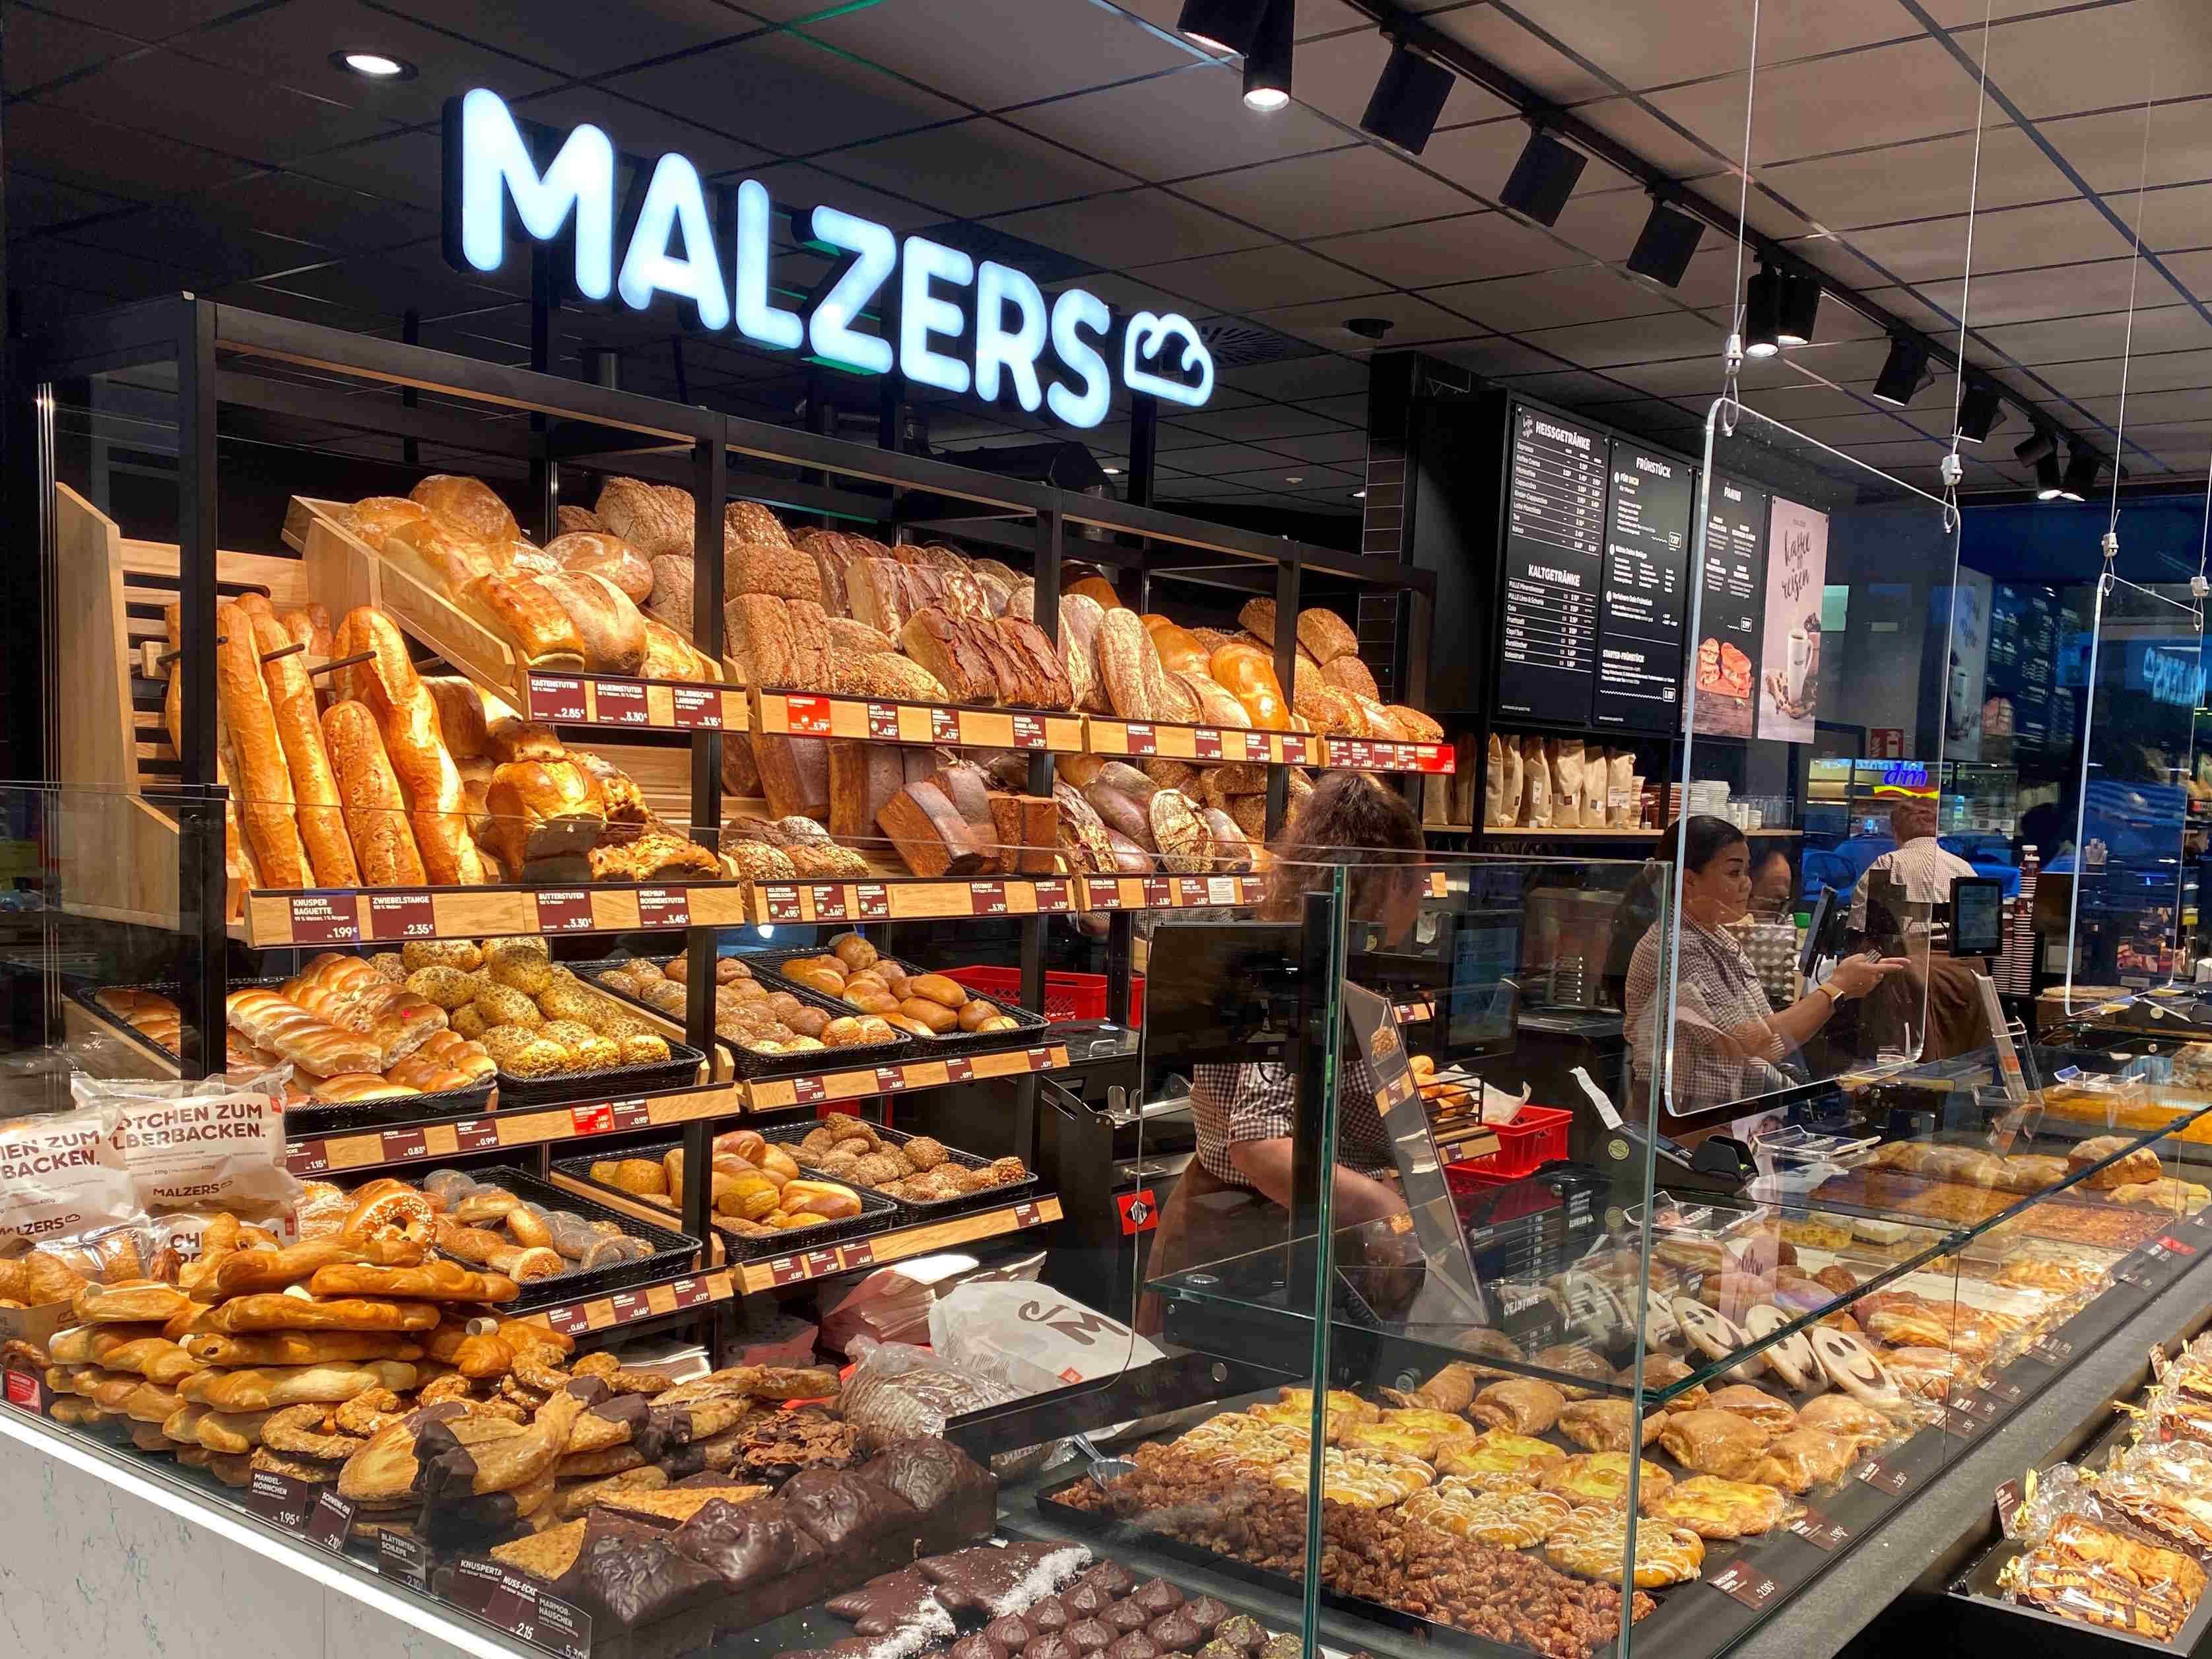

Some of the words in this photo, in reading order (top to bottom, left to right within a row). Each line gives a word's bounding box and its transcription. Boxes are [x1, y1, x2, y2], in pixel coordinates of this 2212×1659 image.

[461, 86, 1112, 429] MALZERS
[1535, 421, 1591, 451] HEISSGETRÄNKE
[1636, 457, 1671, 479] FRÜHSTÜCK
[1528, 563, 1580, 587] KALTGETRÄNKE
[531, 679, 578, 689] KASTENSTUTEN
[561, 708, 585, 718] 2.85€
[1883, 761, 1928, 786] dm
[293, 898, 327, 907] KNUSPER
[372, 895, 429, 905] ZWIEBELSTANGE
[538, 892, 584, 900] BUTTERSTUTEN
[294, 906, 332, 916] BAGUETTE
[333, 926, 357, 938] 1.99€
[407, 924, 434, 935] 2.35€
[215, 1104, 263, 1120] ZUM
[45, 1130, 100, 1148] ZUM
[1, 1149, 100, 1180] BACKEN.
[153, 1183, 220, 1197] MALZERS
[0, 1218, 64, 1236] LZERS
[254, 1473, 283, 1485] MANDEL-
[253, 1481, 287, 1495] HÖRNCHEN
[280, 1510, 300, 1526] 1.95€
[460, 1559, 502, 1576] KNUSPERTA
[539, 1598, 570, 1617] MARMOR-
[539, 1607, 573, 1627] HÄUSCHEN
